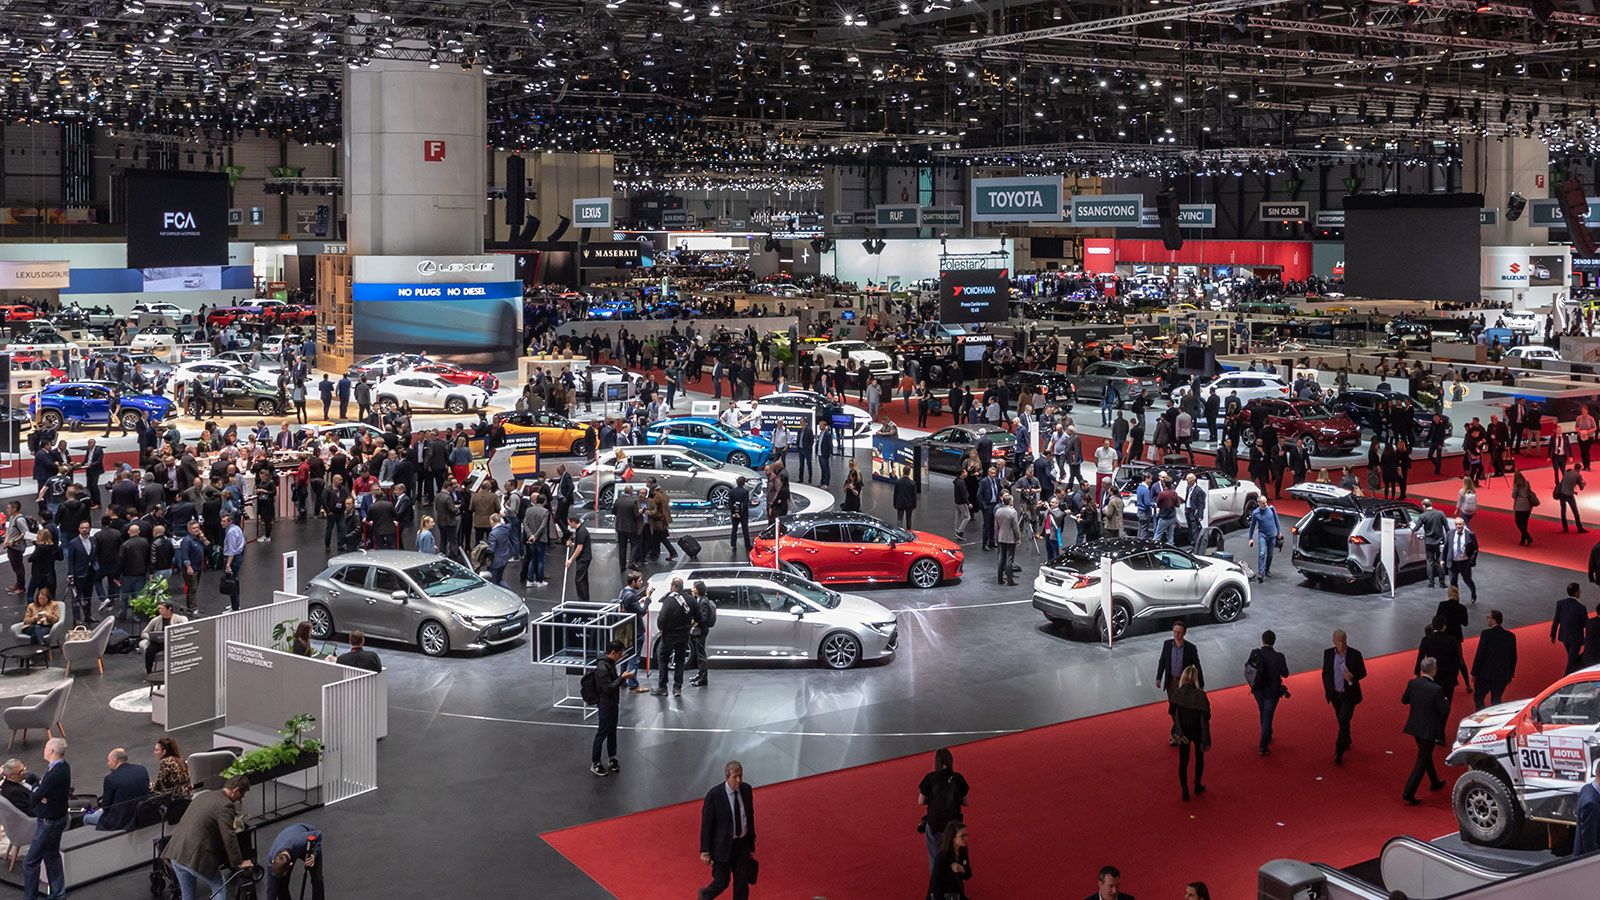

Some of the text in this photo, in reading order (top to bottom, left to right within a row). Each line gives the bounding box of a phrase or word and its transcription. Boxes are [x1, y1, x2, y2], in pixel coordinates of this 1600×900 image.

[430, 142, 441, 156] F
[988, 190, 1043, 208] TOYOTA
[582, 208, 602, 218] LEXUS
[890, 211, 904, 220] RUF
[1078, 206, 1135, 217] SSANGYONG
[1281, 208, 1300, 216] CARS
[164, 211, 196, 228] FCA
[439, 264, 495, 272] LEXUS
[415, 288, 441, 296] PLUGS
[963, 286, 996, 295] YOKOHAMA
[228, 646, 246, 655] TOYOTA
[1554, 750, 1581, 758] MOTUL
[1521, 749, 1550, 769] 301
